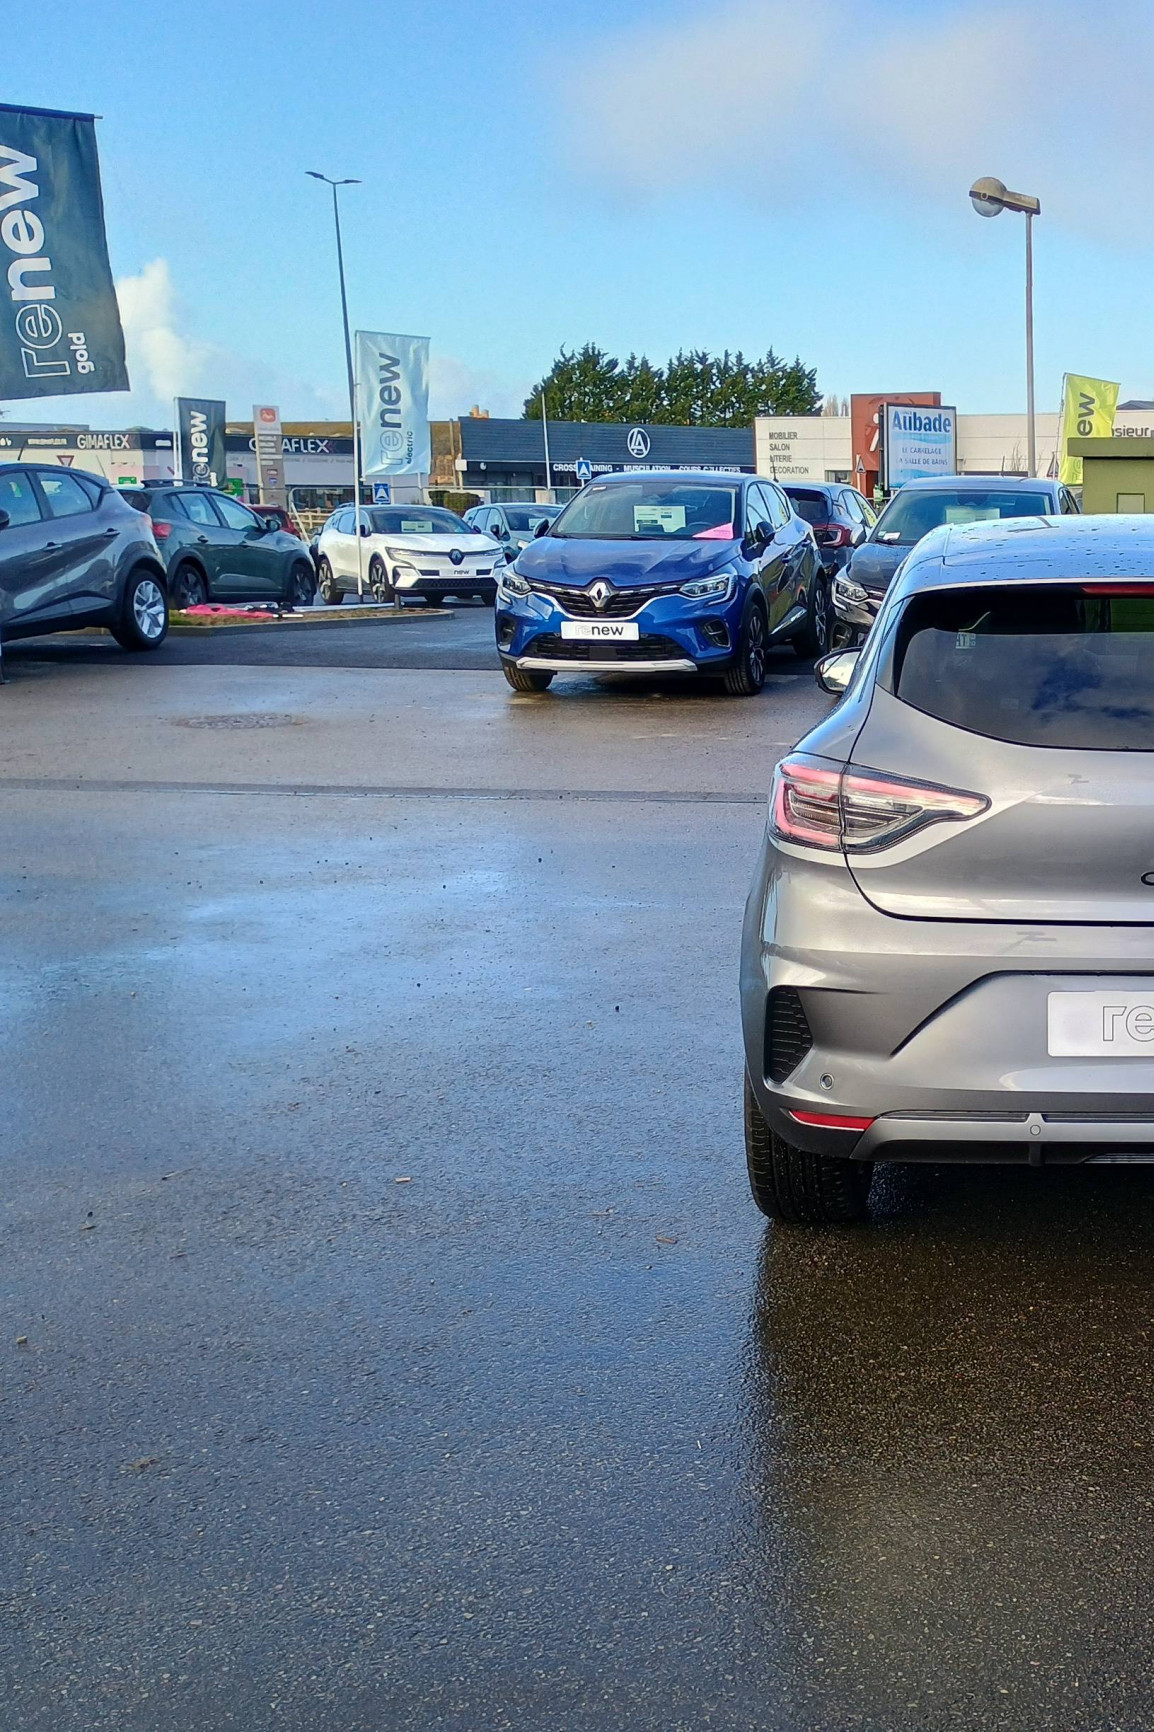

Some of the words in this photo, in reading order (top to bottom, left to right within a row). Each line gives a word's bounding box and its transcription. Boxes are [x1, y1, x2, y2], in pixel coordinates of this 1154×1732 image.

[0, 145, 71, 378] renew
[68, 332, 95, 374] gold
[379, 352, 403, 465] renew
[891, 411, 952, 433] Aubade
[77, 434, 130, 449] GIMAFLEX
[769, 432, 798, 440] MOBILIER
[769, 443, 790, 451] SALON
[770, 455, 792, 463] LITERIE
